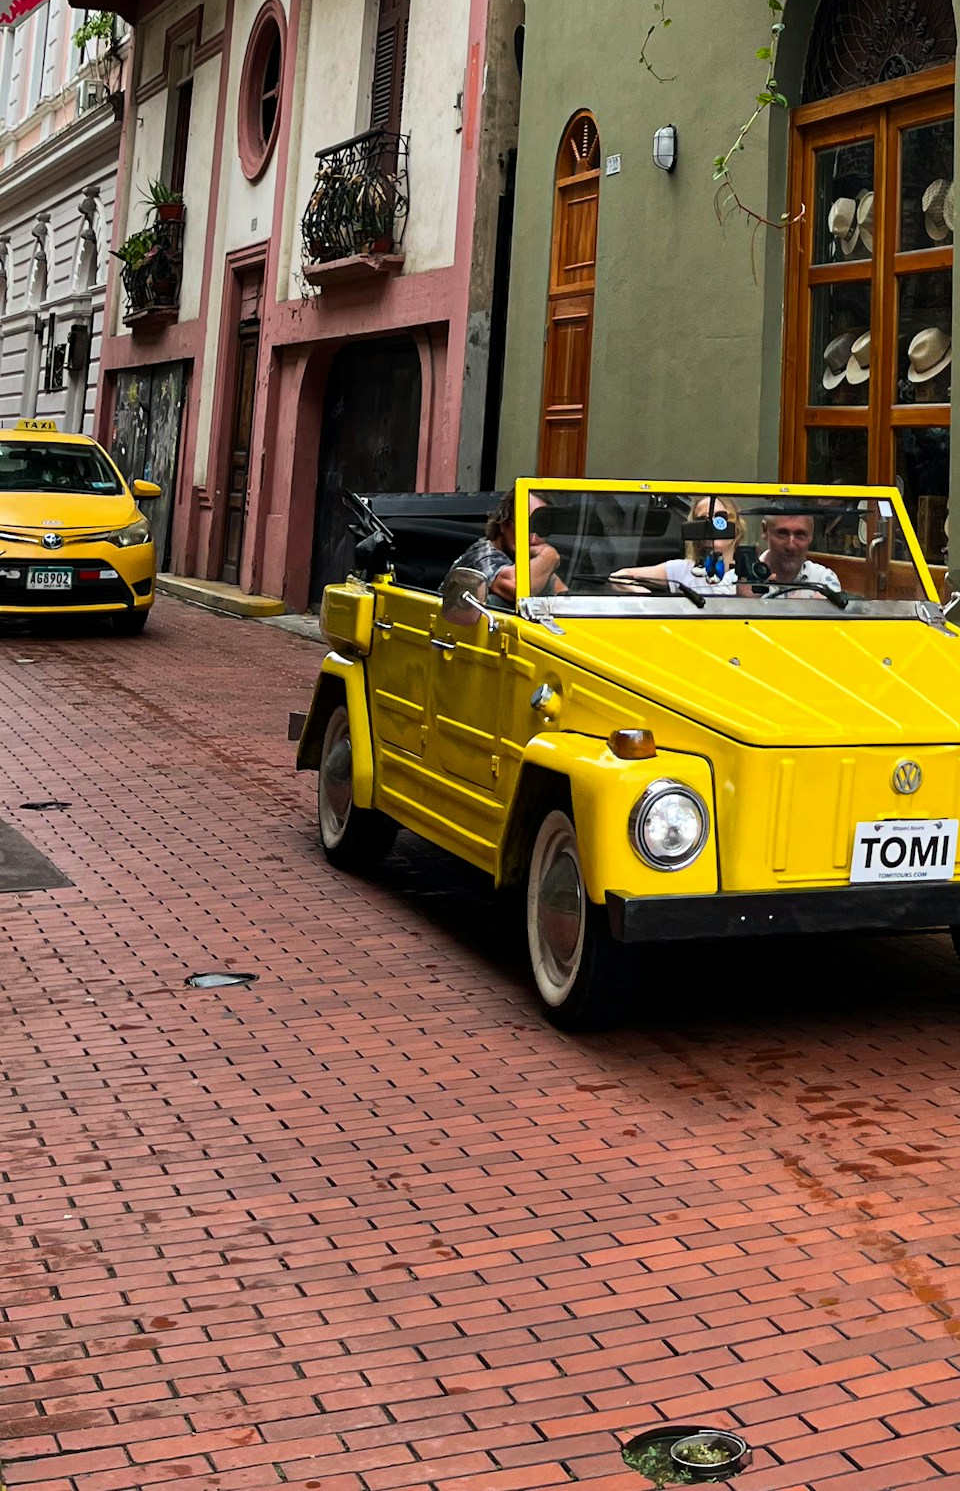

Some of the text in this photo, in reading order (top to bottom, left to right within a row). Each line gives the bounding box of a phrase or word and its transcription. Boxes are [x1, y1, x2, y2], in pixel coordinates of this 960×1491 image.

[24, 421, 52, 429] TAXI
[30, 571, 69, 584] AG8902
[860, 835, 950, 868] TOMI
